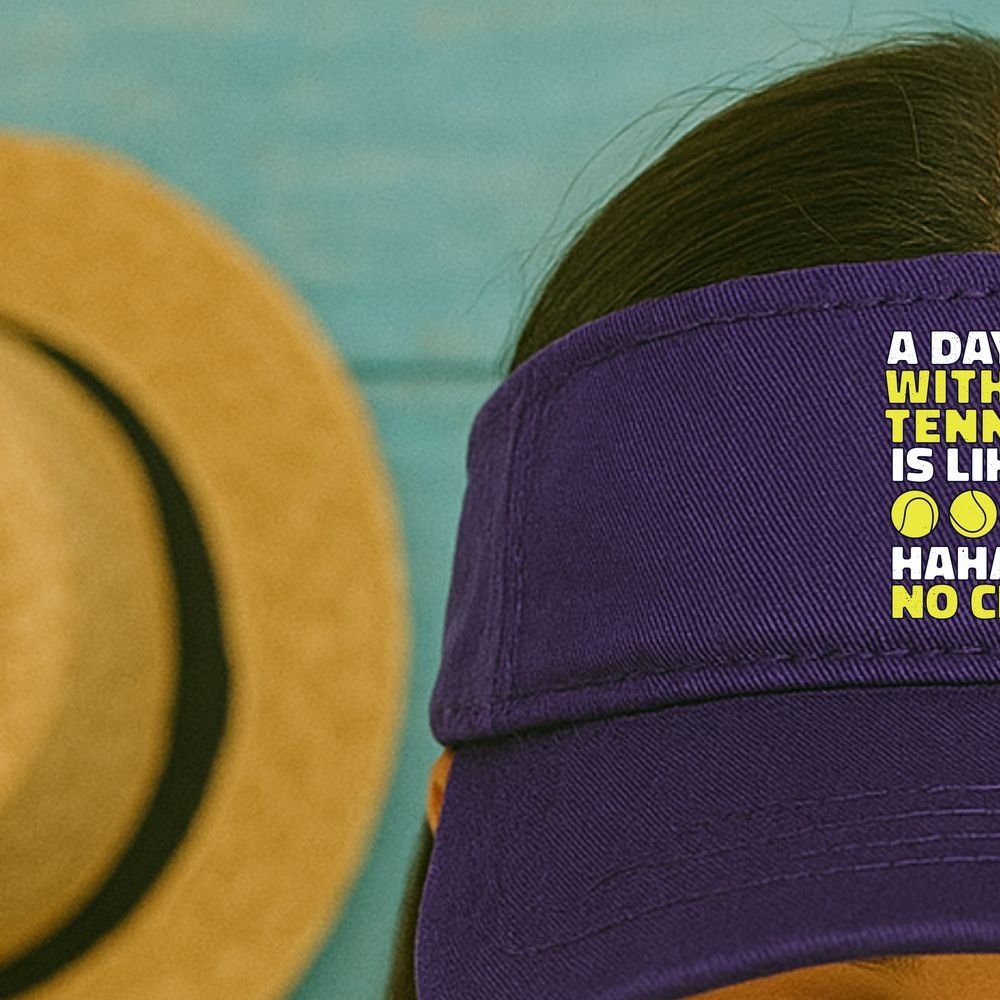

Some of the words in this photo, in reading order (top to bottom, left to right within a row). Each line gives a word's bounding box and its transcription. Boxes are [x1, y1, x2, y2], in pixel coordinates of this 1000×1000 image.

[887, 331, 918, 364] A
[892, 447, 934, 482] IS
[892, 585, 958, 619] NO
